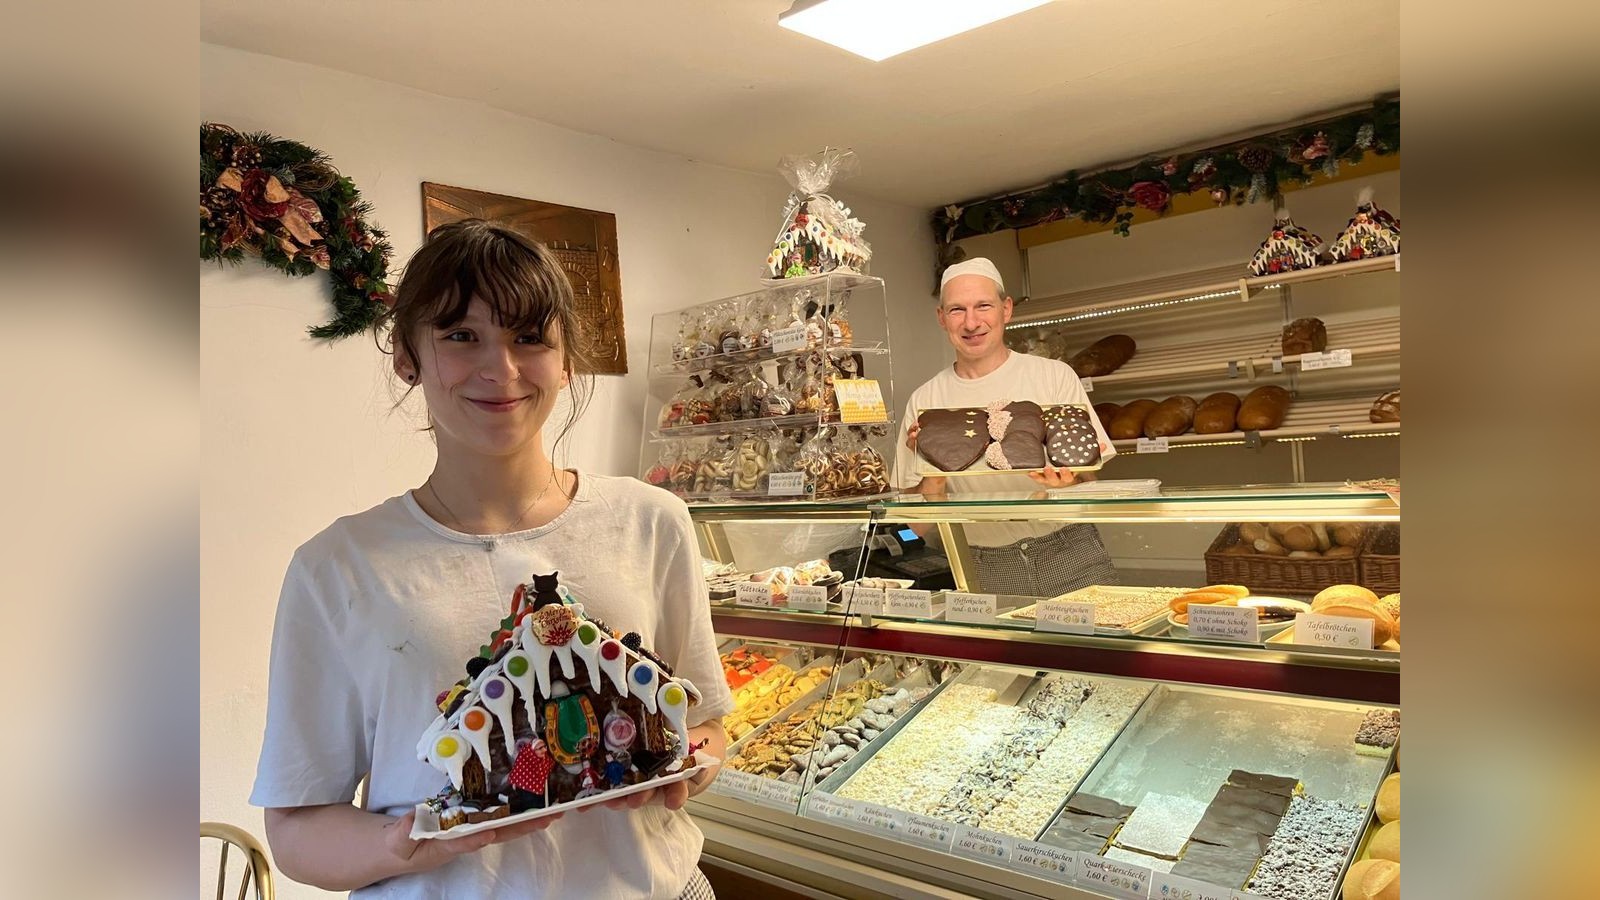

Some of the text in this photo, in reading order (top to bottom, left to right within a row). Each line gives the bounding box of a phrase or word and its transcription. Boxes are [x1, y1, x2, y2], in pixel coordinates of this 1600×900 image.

[1193, 608, 1235, 617] Schweinsohren
[1043, 614, 1056, 622] 1,00
[1226, 619, 1248, 627] Schoko
[1306, 620, 1357, 633] Tafelbrötchen
[1226, 628, 1248, 636] Schoko
[1314, 633, 1331, 642] 0,50
[907, 816, 950, 832] Pflaumenkuchen
[908, 827, 919, 835] 1,60
[967, 831, 1003, 845] Mohnkuchen
[959, 839, 972, 848] 1,60
[1015, 843, 1073, 863] Sauerkirschkuchen
[1018, 854, 1032, 864] 1,60
[1084, 858, 1147, 882] Quark-Eierschecke
[1086, 870, 1109, 882] 1,60 €
